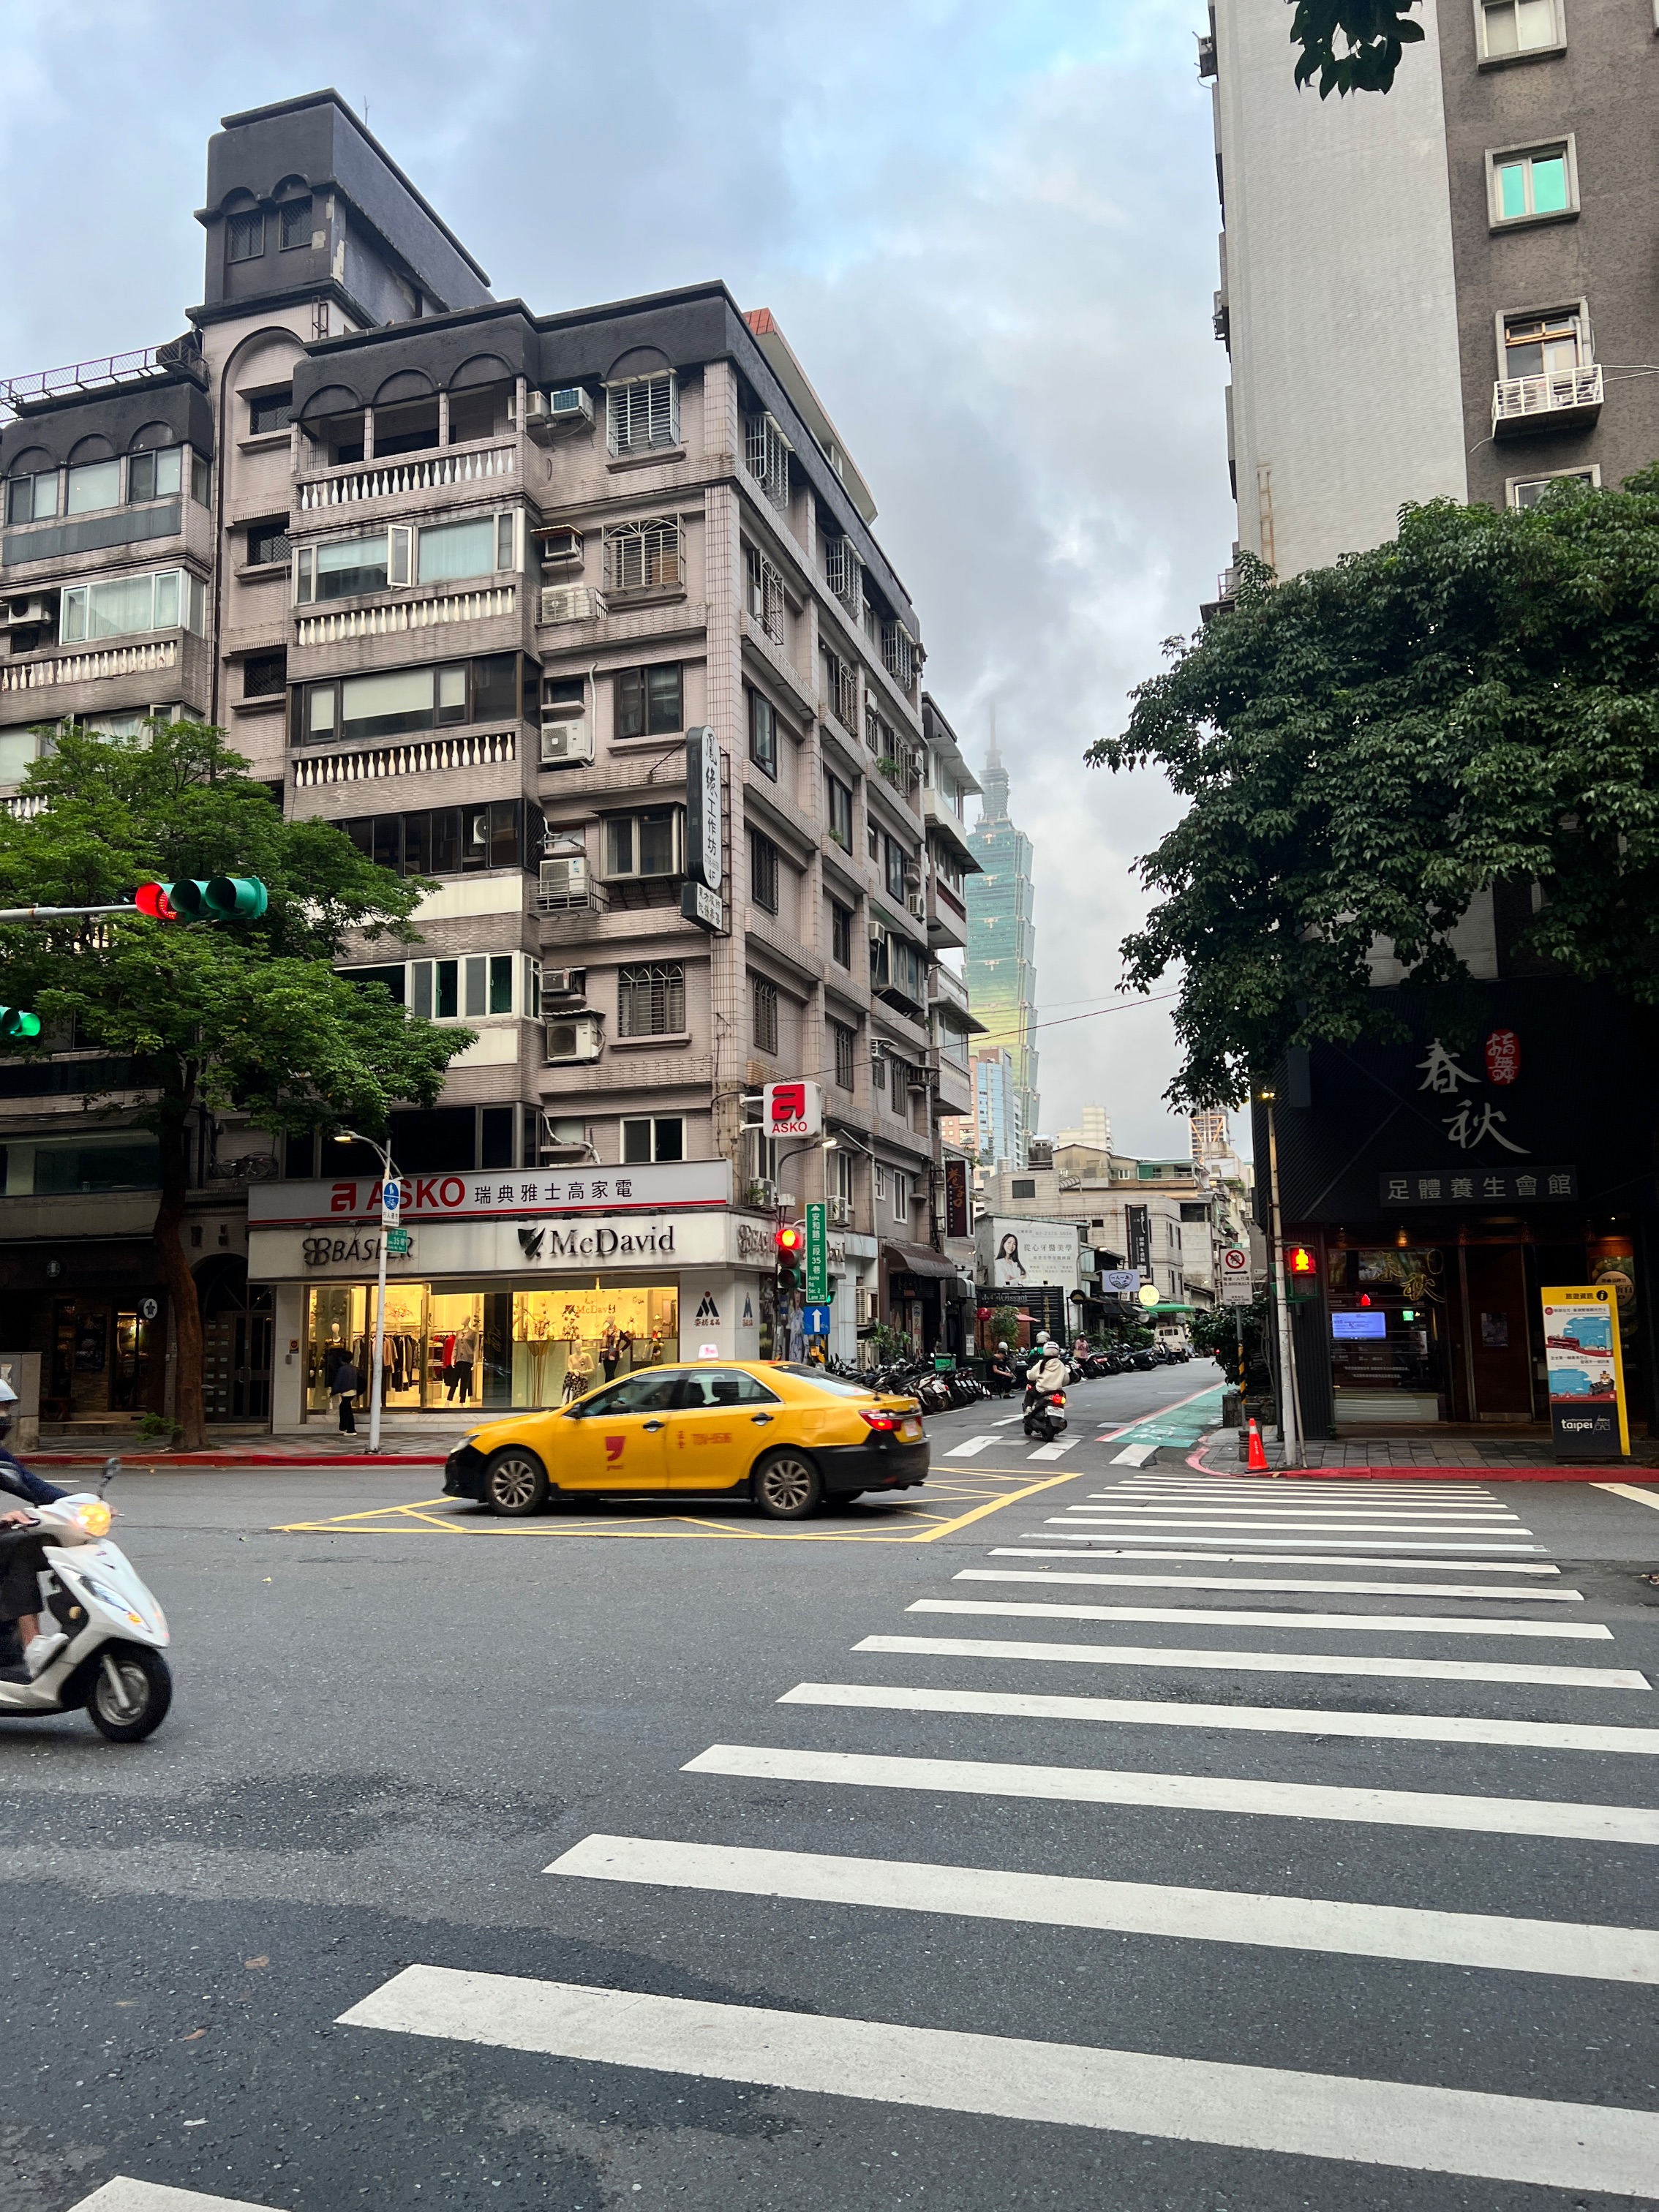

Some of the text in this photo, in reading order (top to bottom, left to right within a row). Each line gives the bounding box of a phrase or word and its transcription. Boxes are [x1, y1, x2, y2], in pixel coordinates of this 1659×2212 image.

[772, 1121, 808, 1134] ASKO
[366, 1177, 465, 1211] ASKO
[475, 1179, 632, 1205] 瑞典雅士高家電
[1388, 1173, 1573, 1201] 足體養生會館
[550, 1225, 676, 1255] McDavid
[1560, 1418, 1593, 1432] taipei
